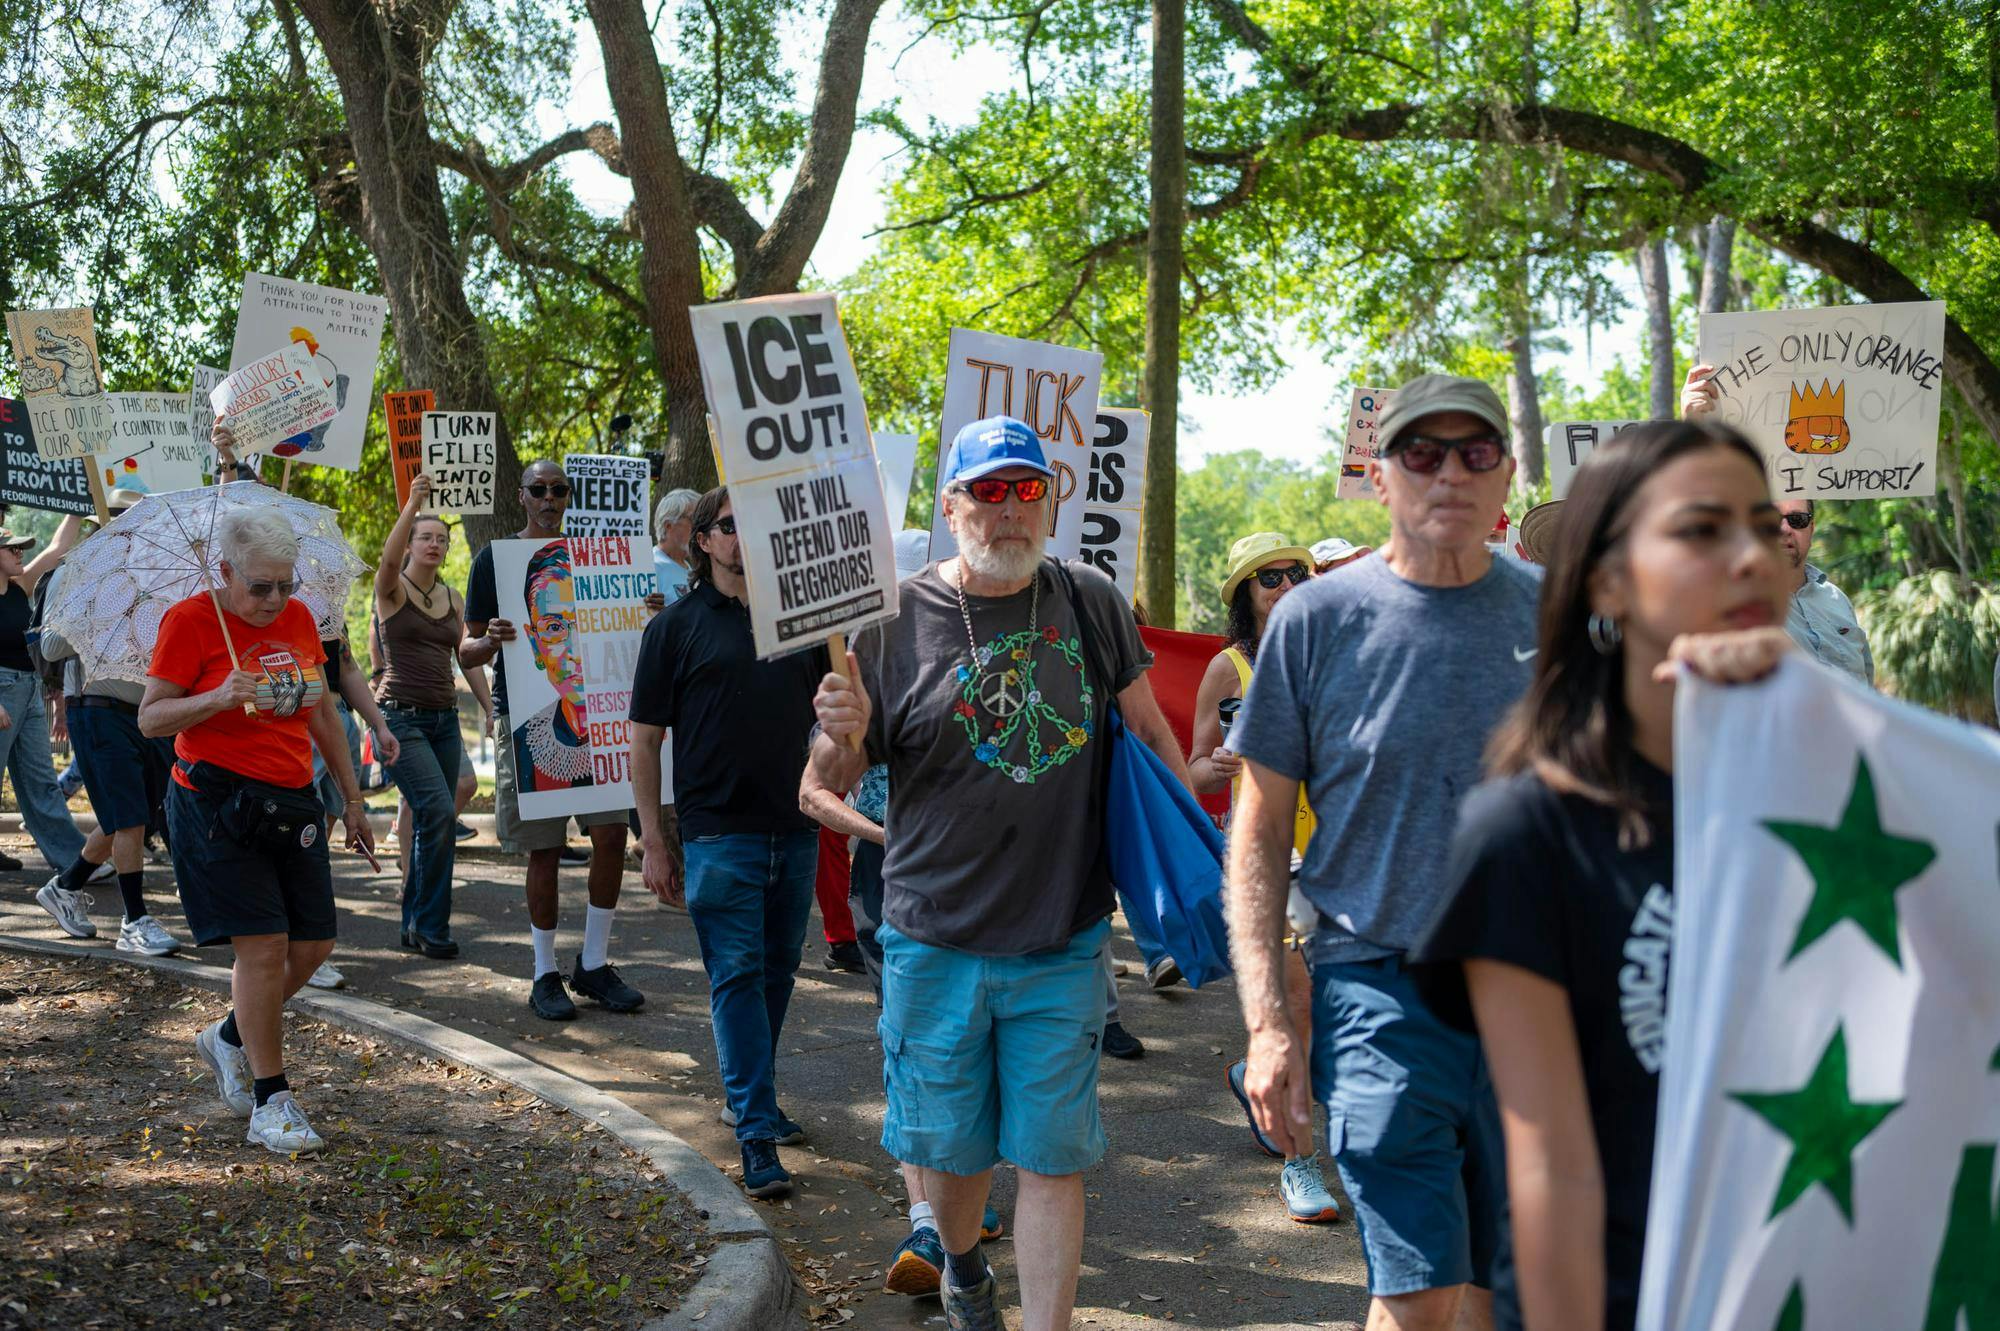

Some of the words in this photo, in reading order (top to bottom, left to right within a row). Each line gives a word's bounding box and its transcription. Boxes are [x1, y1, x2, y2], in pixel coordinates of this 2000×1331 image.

[260, 282, 295, 298] THANK
[300, 290, 319, 301] YOU
[324, 296, 344, 306] FOR
[350, 301, 379, 313] YOUR
[263, 297, 324, 315] ATTENTION
[352, 314, 375, 326] THIS
[326, 322, 368, 338] MATTER
[228, 352, 288, 396] HISTORY
[723, 312, 842, 410] ICE
[1710, 346, 1772, 397] THE
[1780, 330, 1853, 364] ONLY
[1854, 335, 1943, 390] ORANGE
[196, 370, 209, 389] DO
[120, 397, 142, 413] THIS
[144, 397, 160, 413] ASS
[163, 398, 186, 414] MAKE
[224, 388, 271, 415] WARNED
[391, 395, 407, 416] THE
[409, 393, 427, 413] ONLY
[966, 358, 1086, 447] TUCK
[33, 410, 60, 434] ICE
[64, 406, 89, 430] OUT
[91, 404, 104, 428] OF
[122, 420, 166, 437] COUNTRY
[169, 420, 190, 437] LOOK
[427, 414, 491, 439] TURN
[746, 404, 849, 461] OUT!
[4, 432, 25, 446] TO
[44, 433, 73, 458] OUR
[78, 430, 113, 454] SWAMP
[7, 449, 41, 470] KIDS
[162, 445, 197, 462] SMALL?
[428, 442, 494, 465] FILES
[566, 457, 616, 467] MONEY
[619, 459, 647, 469] FOR
[8, 469, 54, 492] FROM
[59, 475, 89, 497] ICE
[435, 469, 492, 484] INTO
[566, 466, 647, 479] PEOPLE'S
[1781, 466, 1805, 492] I
[1816, 462, 1924, 491] SUPPORT!
[2, 490, 45, 506] PEDOPHILE
[46, 496, 95, 515] PRESIDENTS
[430, 486, 492, 508] TRIALS
[566, 477, 641, 513] NEEDS
[776, 483, 807, 523] WE
[808, 475, 852, 515] WILL
[566, 516, 601, 526] NOT
[605, 518, 643, 528] WAR
[570, 537, 632, 567] WHEN
[769, 518, 835, 570] DEFEND
[837, 510, 871, 554] OUR
[574, 572, 656, 601] INJUSTICE
[776, 550, 875, 611] NEIGHBORS!
[587, 691, 632, 714] RESIST
[590, 720, 632, 747] BECO
[593, 751, 632, 785] DUT
[1618, 882, 1673, 1074] EDUCATE
